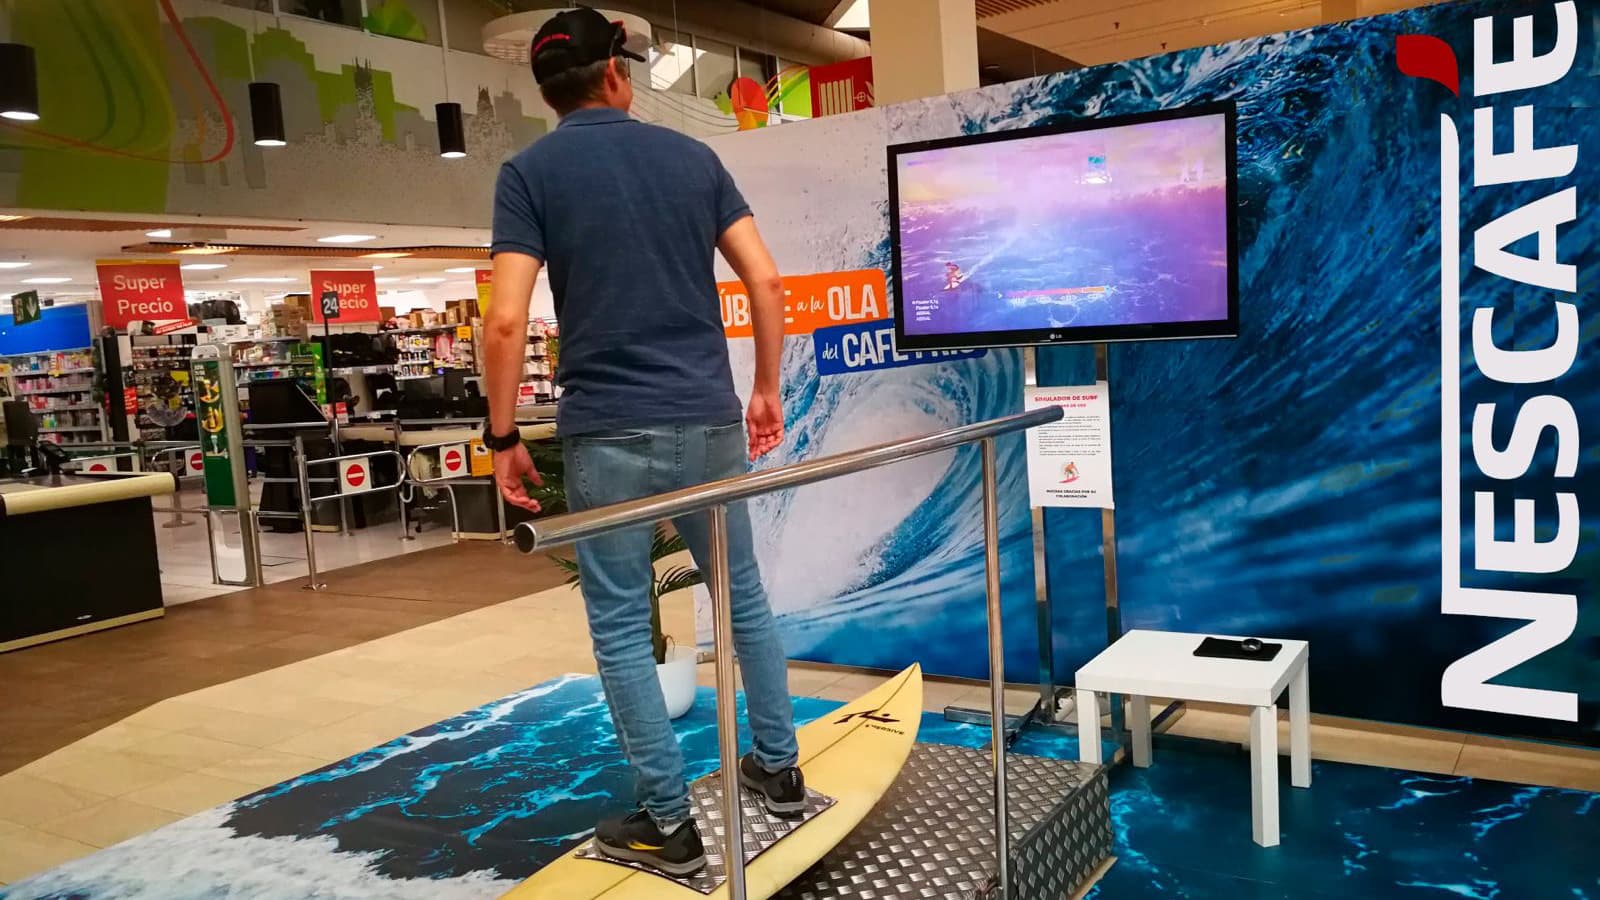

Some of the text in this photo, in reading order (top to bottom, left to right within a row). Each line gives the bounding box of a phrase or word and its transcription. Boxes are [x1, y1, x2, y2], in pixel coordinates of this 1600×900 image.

[113, 275, 166, 293] Super
[323, 280, 366, 296] Super
[117, 297, 173, 315] Precio
[323, 297, 339, 314] 24
[339, 294, 368, 309] ecio
[719, 284, 880, 328] ÚBE a la OLA
[822, 342, 839, 360] del
